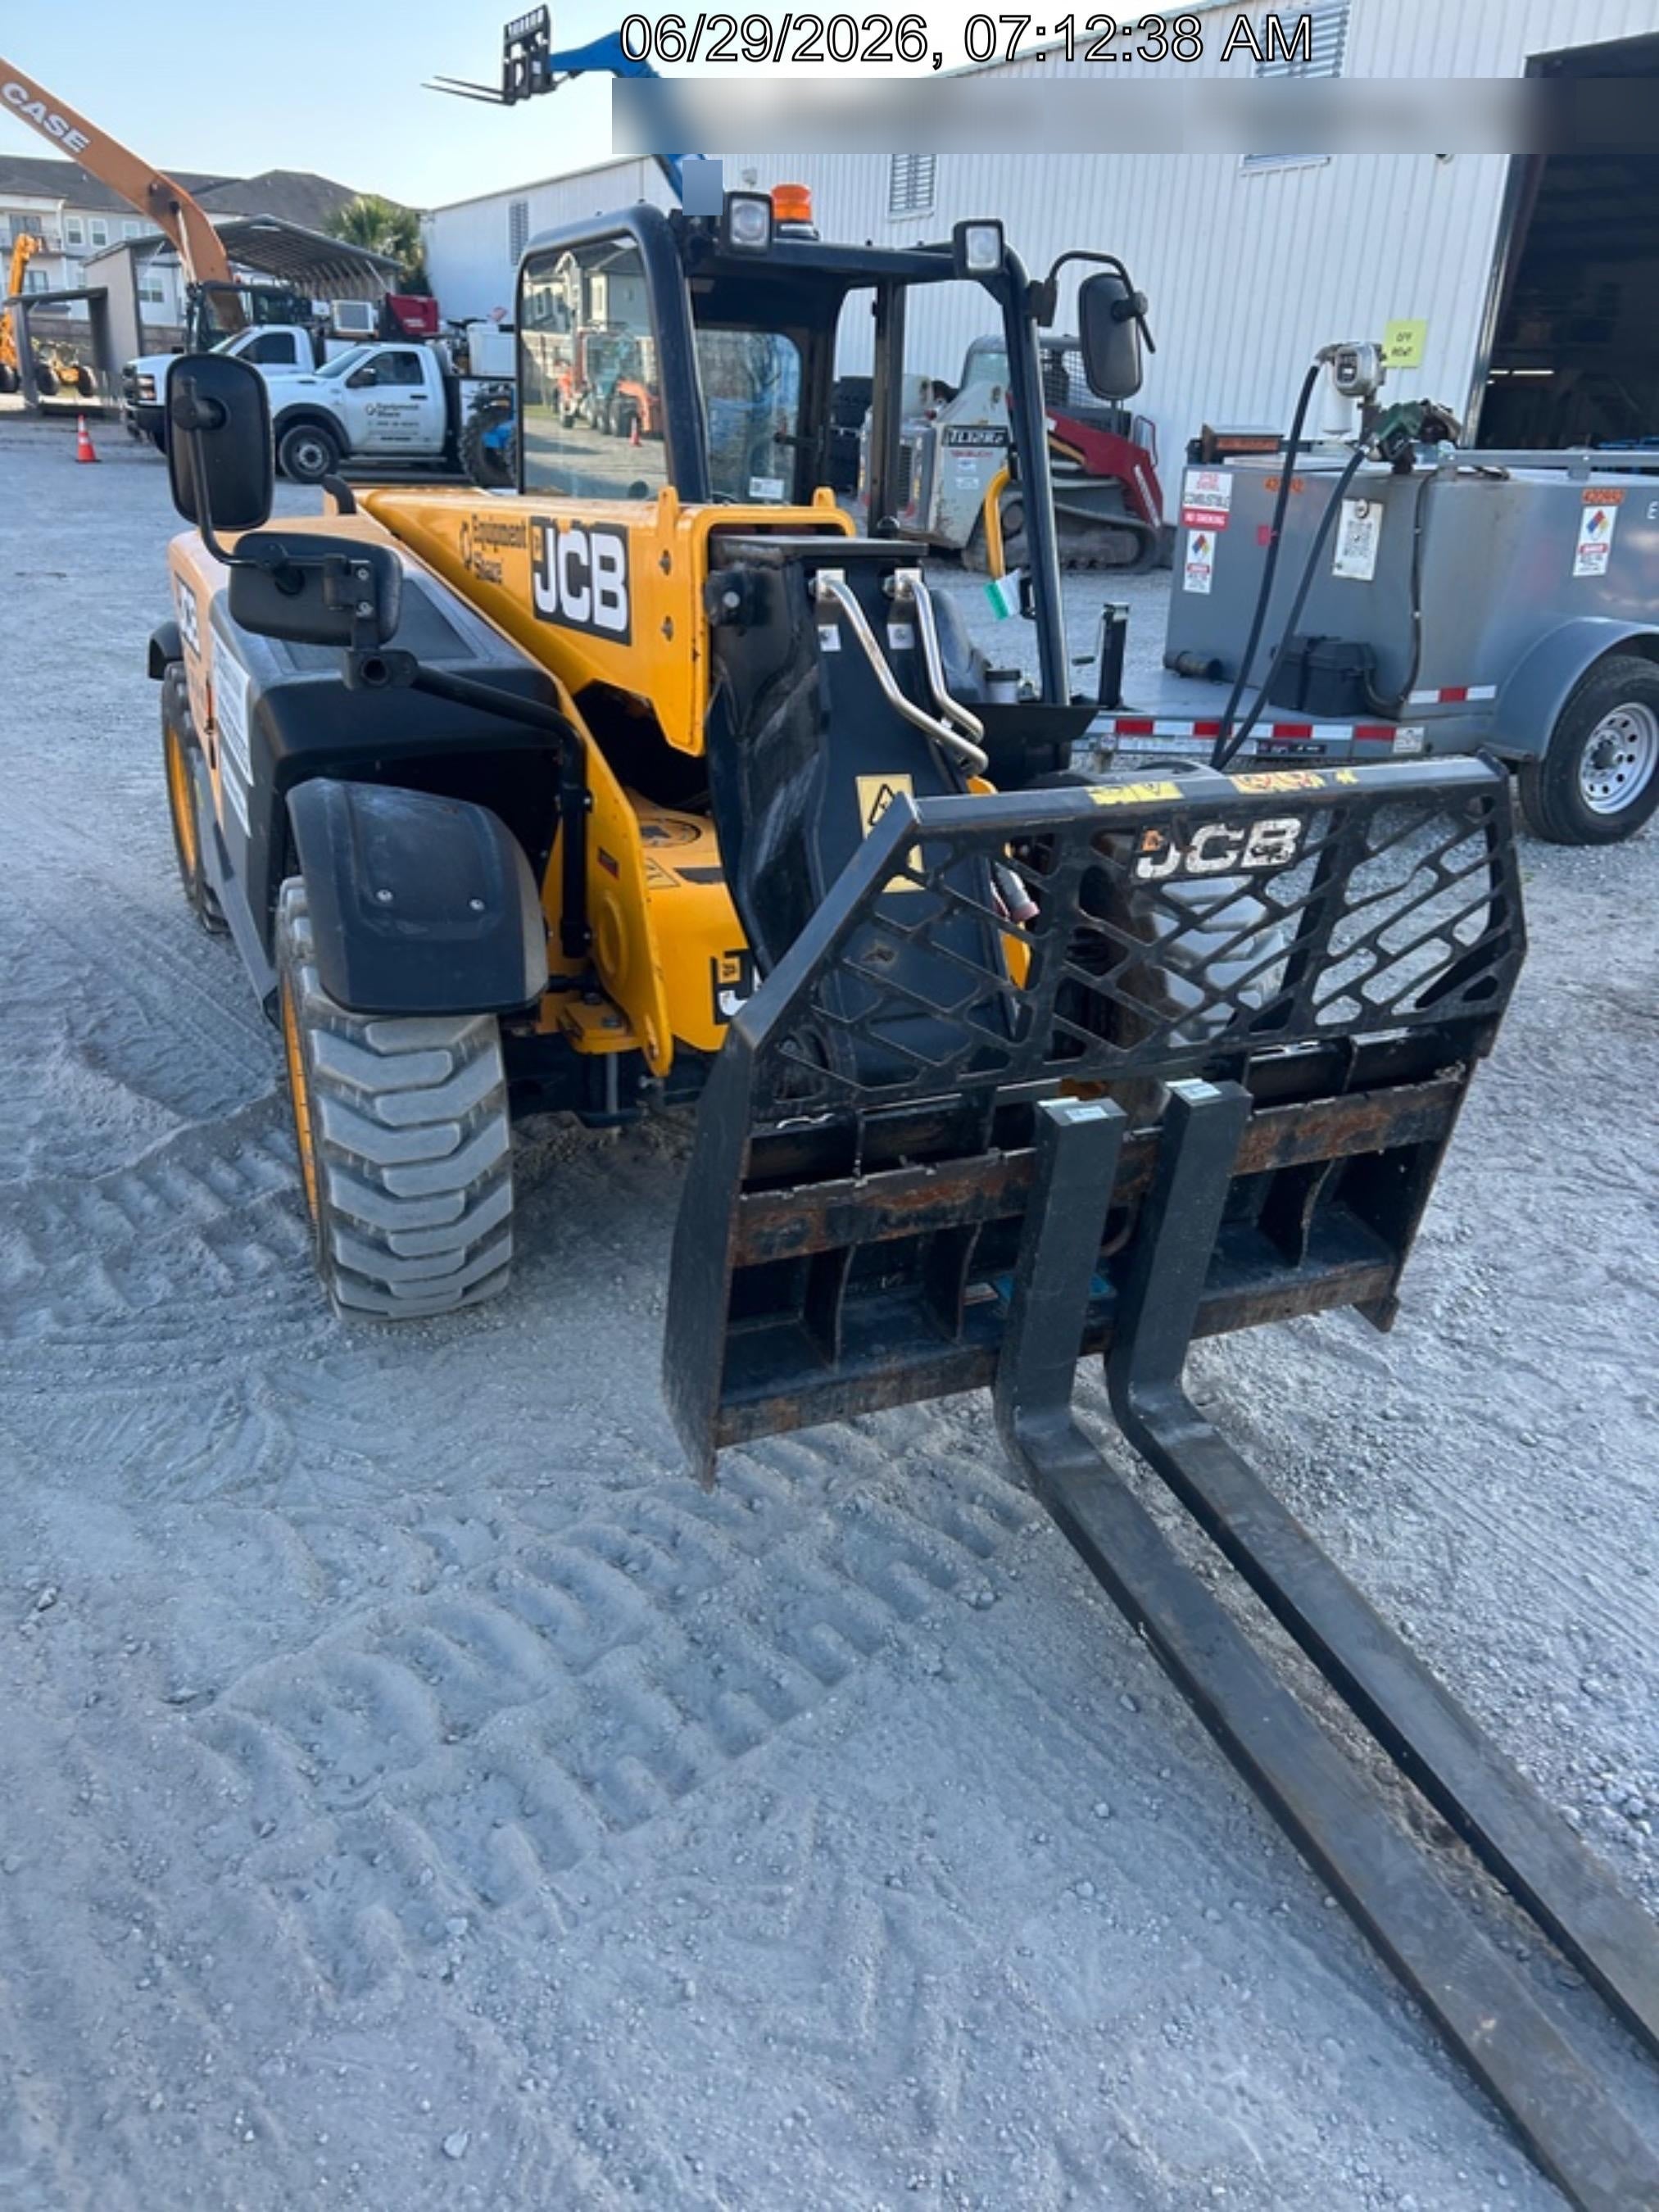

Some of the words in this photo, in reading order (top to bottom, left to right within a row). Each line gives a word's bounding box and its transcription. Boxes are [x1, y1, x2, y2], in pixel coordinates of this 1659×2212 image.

[2, 82, 91, 153] CASE
[534, 527, 628, 632] JCB
[1137, 818, 1301, 879] JCB
